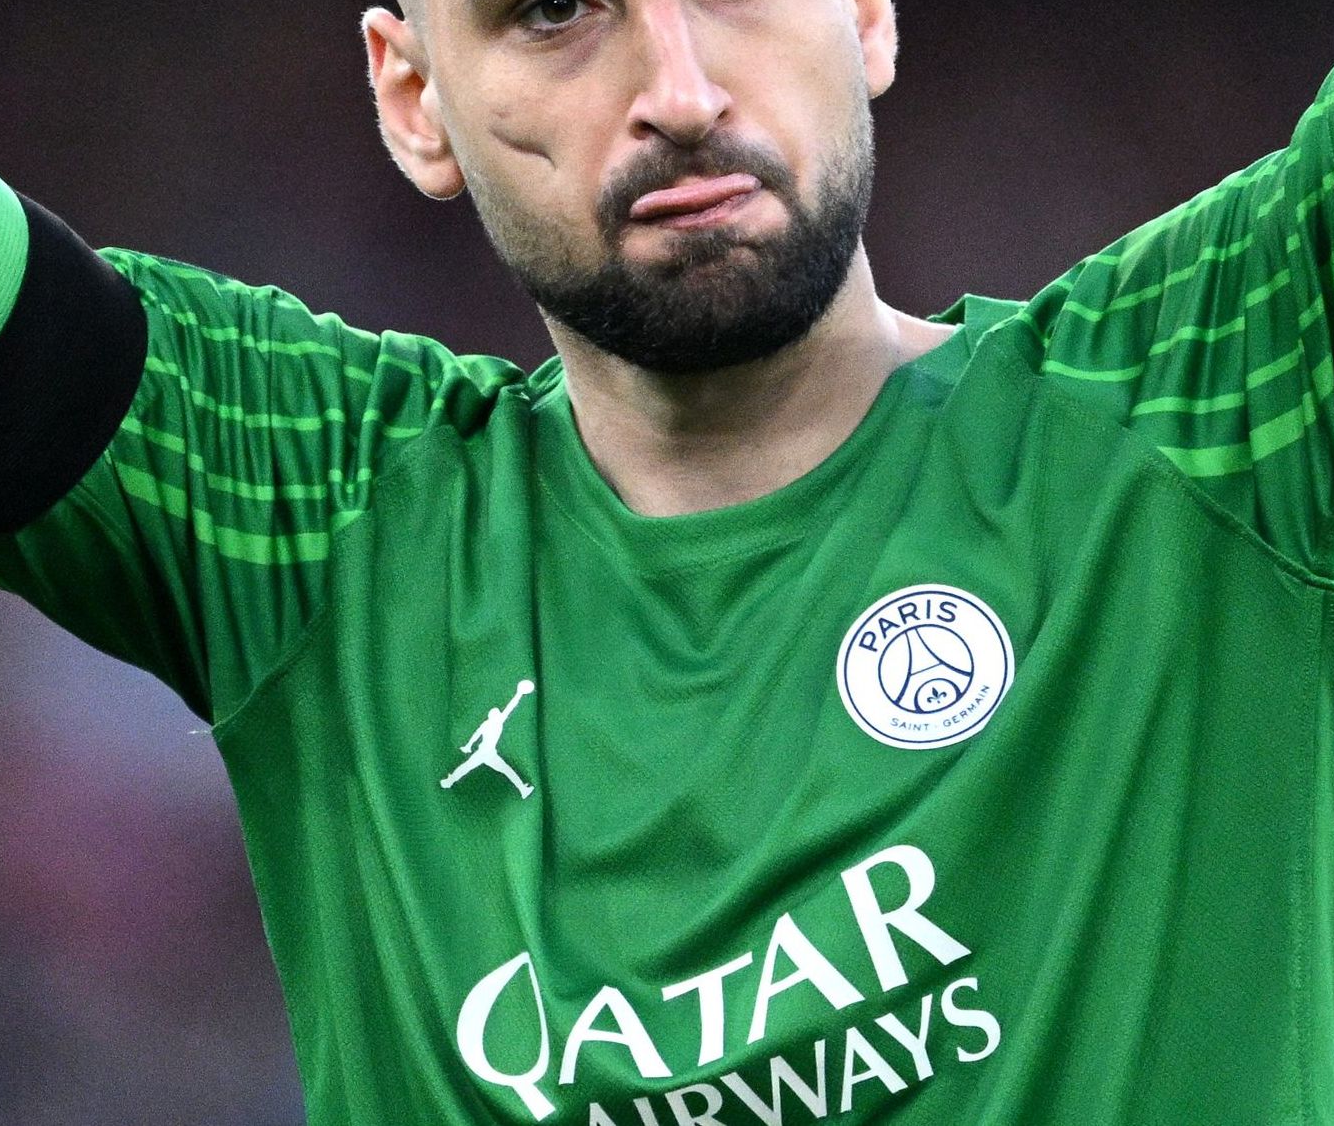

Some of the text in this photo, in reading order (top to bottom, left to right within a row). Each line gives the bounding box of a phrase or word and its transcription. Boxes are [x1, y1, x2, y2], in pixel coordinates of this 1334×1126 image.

[858, 599, 958, 652] PARIS
[890, 685, 990, 731] SAINT GERMAIN
[456, 844, 971, 1122] QATAR
